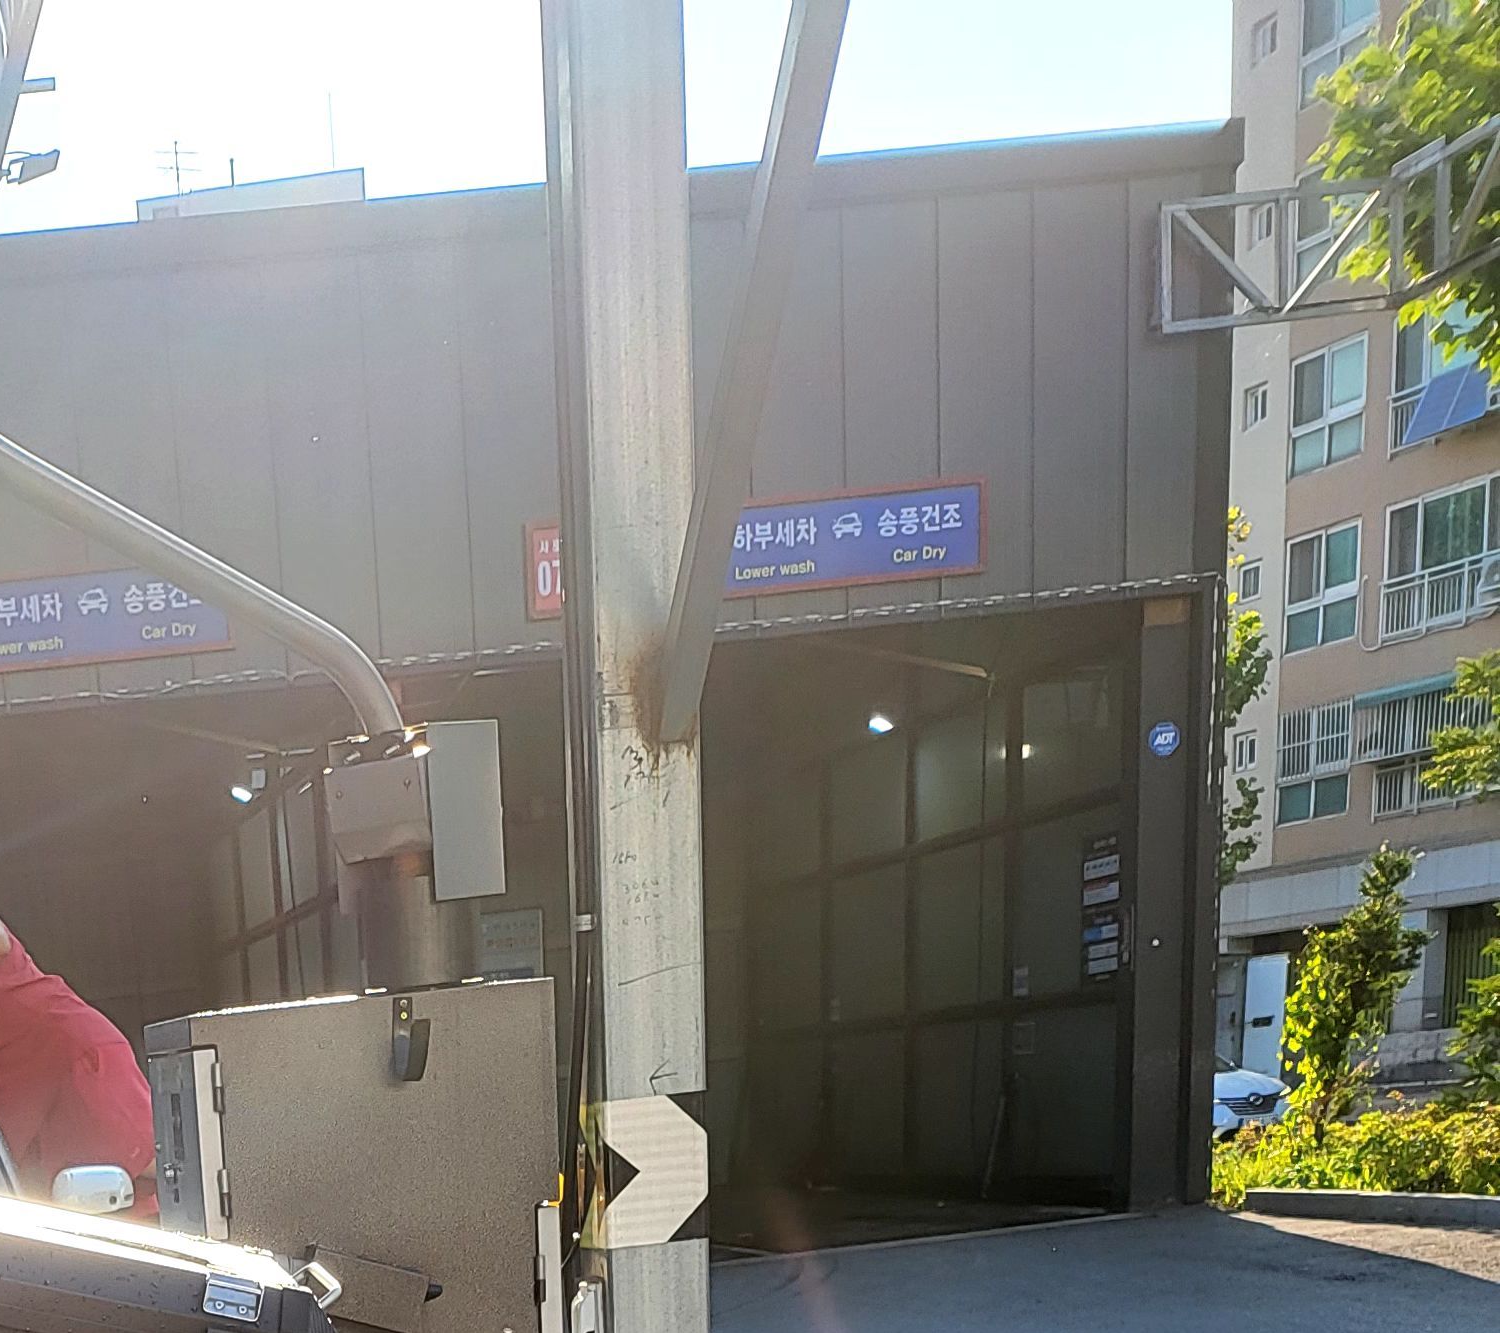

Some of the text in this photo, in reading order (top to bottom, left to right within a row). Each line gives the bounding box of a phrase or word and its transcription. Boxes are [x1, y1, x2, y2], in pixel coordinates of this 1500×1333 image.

[733, 503, 963, 552] 하부세차 송풍건조
[735, 545, 947, 581] Lower wash Car Dry
[124, 582, 203, 614] 송풍건
[26, 636, 64, 653] wash
[142, 625, 167, 640] Car
[171, 622, 197, 639] Dry
[1153, 731, 1175, 746] ADT
